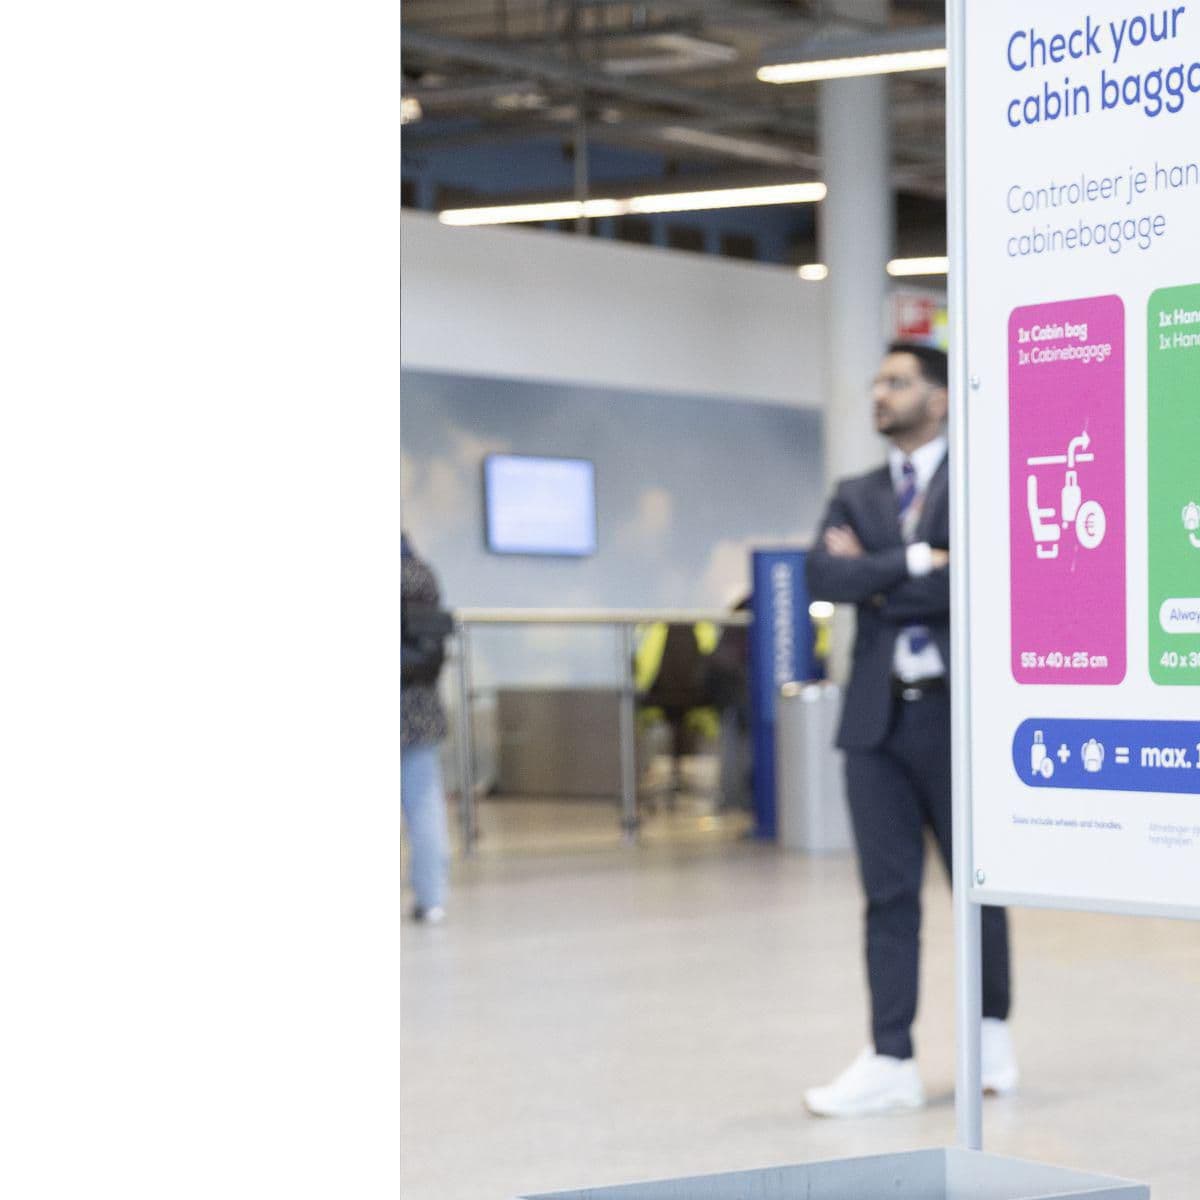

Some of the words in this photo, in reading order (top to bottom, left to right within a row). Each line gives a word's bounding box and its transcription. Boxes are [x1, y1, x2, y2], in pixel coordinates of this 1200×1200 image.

[1007, 16, 1101, 71] Check
[1109, 6, 1185, 63] your
[1007, 77, 1090, 128] cabin
[1007, 174, 1122, 214] Controleer
[1126, 165, 1147, 204] je
[1007, 214, 1166, 257] cabinebagage
[1159, 311, 1172, 327] 1x
[1018, 328, 1031, 343] 1x
[1031, 323, 1064, 342] Cabin
[1064, 321, 1088, 342] bag
[1159, 333, 1171, 350] 1x
[1018, 349, 1030, 365] 1x
[1031, 343, 1112, 363] Cabinebagage
[1021, 652, 1037, 668] 55
[1037, 655, 1046, 668] x
[1045, 652, 1063, 668] 40
[1063, 655, 1071, 668] x
[1072, 652, 1089, 668] 25
[1090, 656, 1108, 668] cm
[1160, 652, 1178, 668] 40
[1179, 655, 1188, 668] x
[1140, 746, 1192, 769] max.
